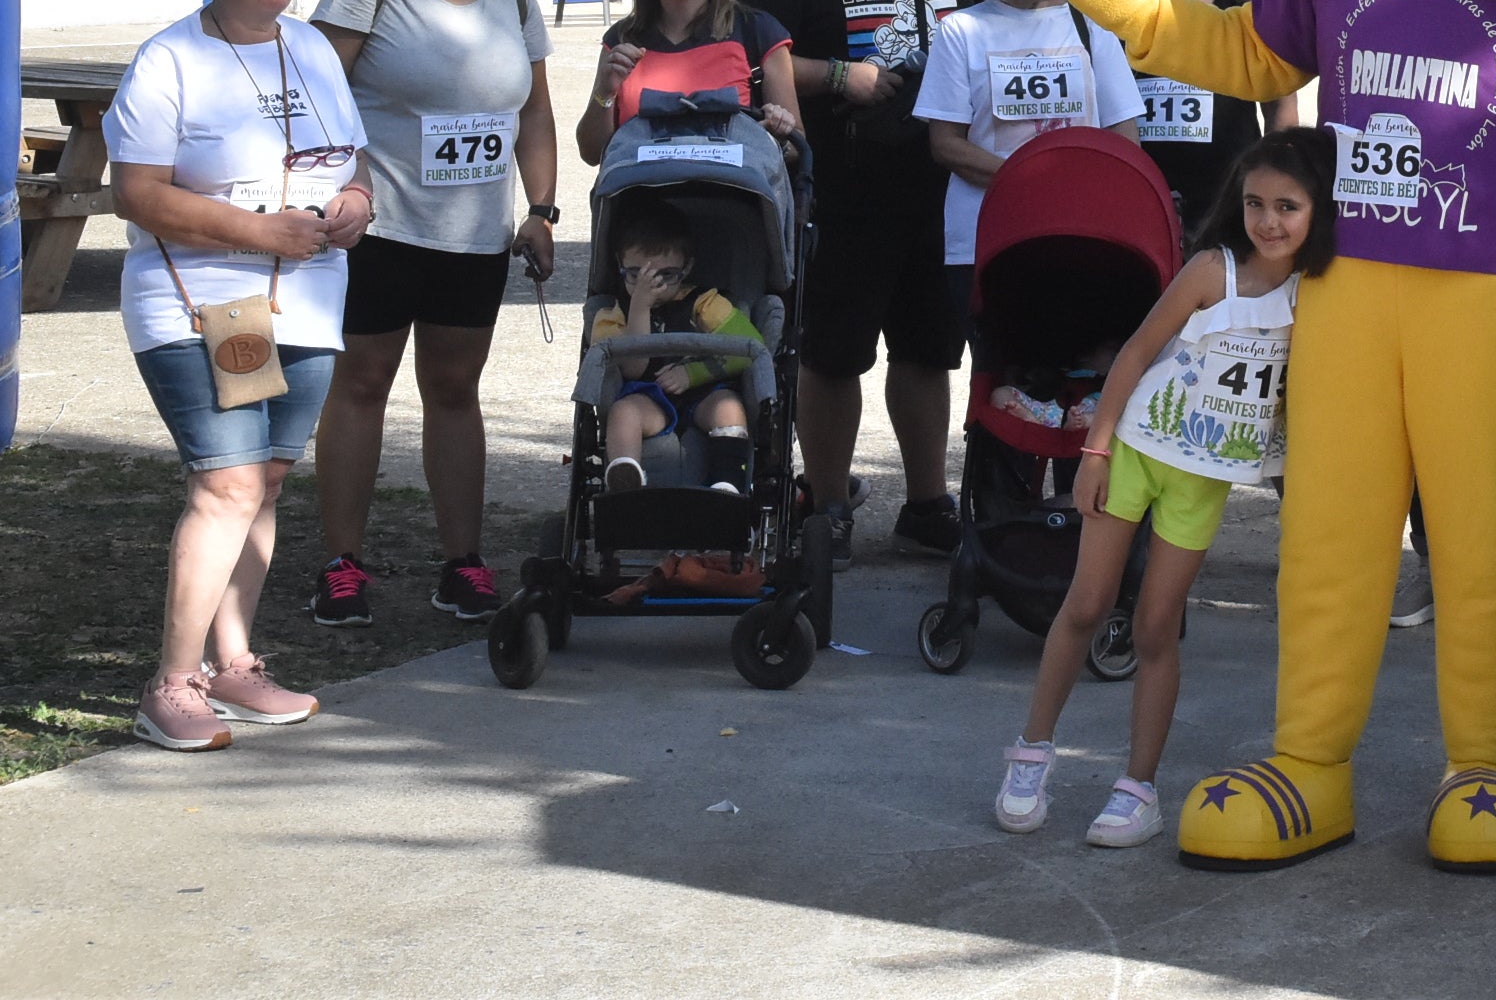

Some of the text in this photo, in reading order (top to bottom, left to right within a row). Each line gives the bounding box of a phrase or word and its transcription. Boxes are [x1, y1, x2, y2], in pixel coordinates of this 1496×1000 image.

[998, 61, 1032, 71] marcha
[1004, 73, 1068, 100] 461
[1337, 30, 1348, 49] de
[1466, 118, 1496, 151] León
[1350, 49, 1479, 109] BRILLANTINA
[997, 99, 1083, 116] FUENTES DE BÉJAR
[1138, 97, 1202, 122] 413
[430, 119, 467, 133] marcha
[1138, 124, 1209, 138] ENTES DE BÉJAR
[435, 134, 503, 165] 479
[1351, 140, 1420, 178] 536
[426, 163, 507, 181] FUENTES DE BÉJAR
[1337, 178, 1418, 198] FUENTES DE BÉJ
[229, 341, 257, 369] B
[1220, 340, 1265, 357] marcha
[1202, 394, 1257, 418] FUENTES
[1260, 404, 1273, 419] DE
